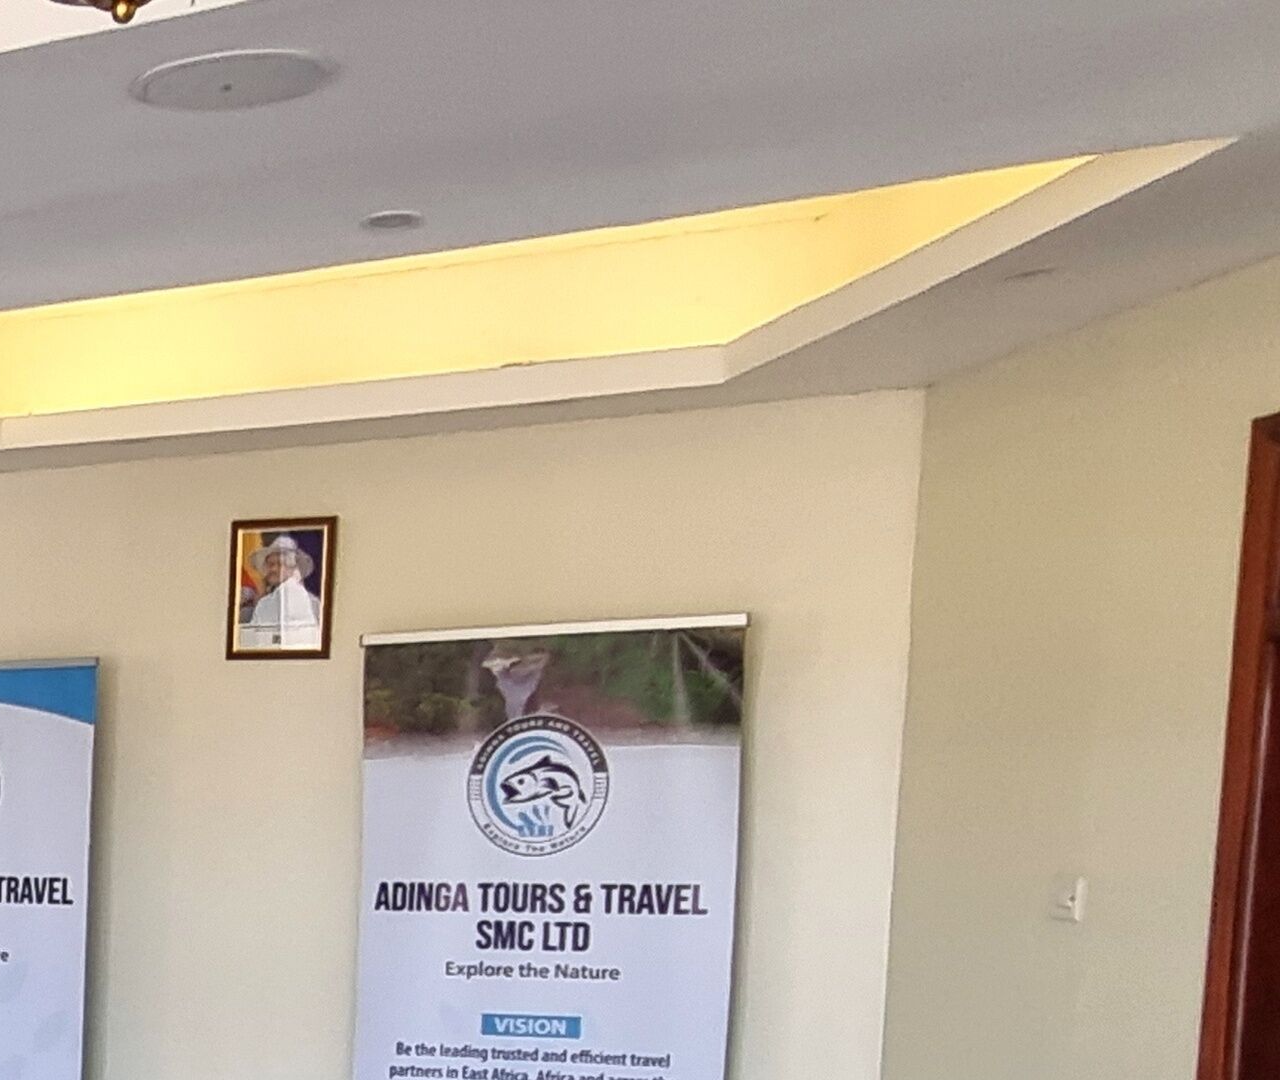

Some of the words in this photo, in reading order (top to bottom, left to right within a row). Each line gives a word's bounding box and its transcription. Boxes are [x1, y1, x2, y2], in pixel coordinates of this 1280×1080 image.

[375, 882, 468, 913] ADINGA
[477, 883, 565, 914] TOURS
[574, 885, 592, 914] &
[600, 884, 708, 915] TRAVEL
[476, 920, 534, 950] SMC
[542, 922, 590, 952] LTD
[445, 961, 514, 980] Explore
[519, 963, 550, 979] the
[555, 964, 620, 980] Nature
[494, 1018, 566, 1035] VISION
[396, 1042, 411, 1056] Be
[415, 1044, 436, 1056] the
[440, 1044, 488, 1062] leading
[492, 1048, 538, 1062] trusted
[542, 1050, 566, 1063] and
[571, 1050, 626, 1066] efficient
[630, 1053, 670, 1068] travel
[390, 1066, 442, 1079] partners
[446, 1066, 458, 1078] in
[462, 1066, 488, 1080] East
